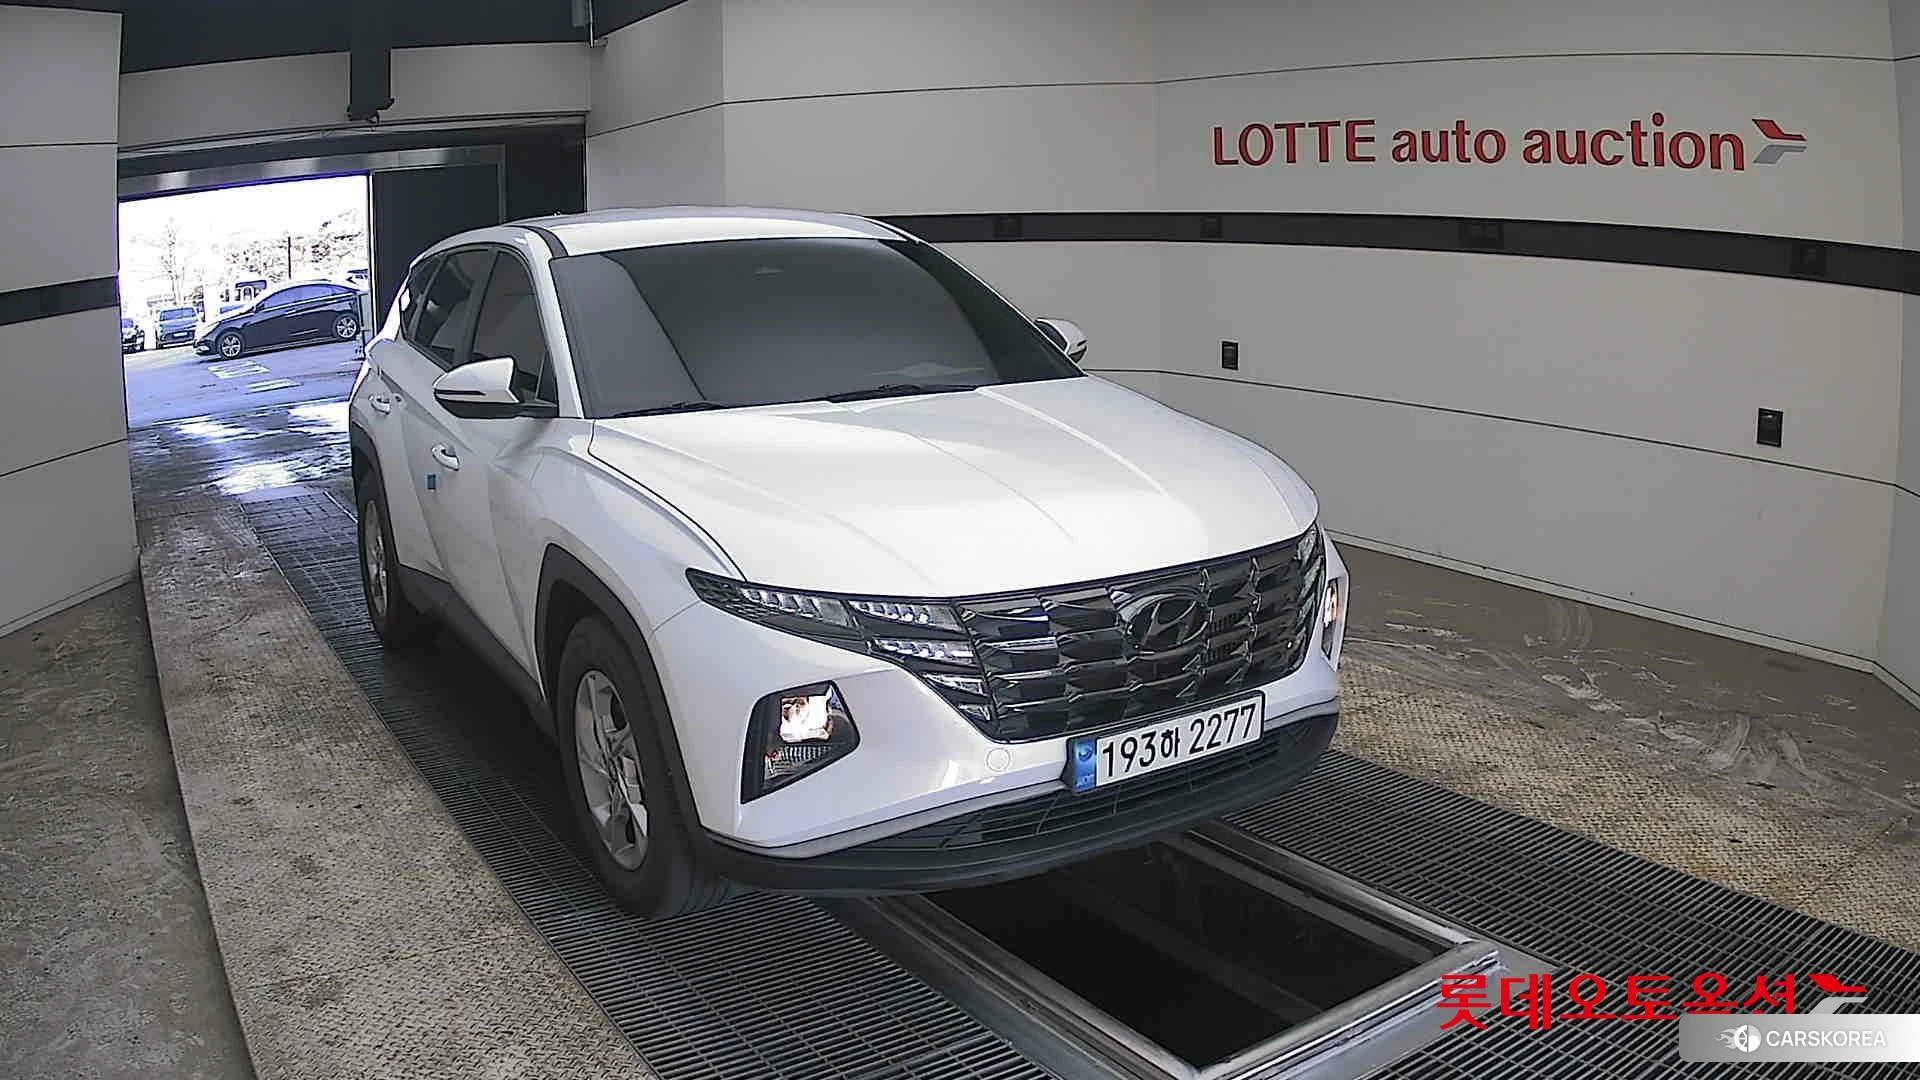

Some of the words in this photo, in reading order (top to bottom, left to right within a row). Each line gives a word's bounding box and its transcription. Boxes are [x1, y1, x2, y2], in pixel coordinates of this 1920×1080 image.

[1213, 119, 1376, 165] LOTTE
[1391, 119, 1506, 164] auto
[1522, 112, 1745, 171] auction
[1102, 727, 1181, 778] 193하
[1189, 703, 1257, 755] 2277
